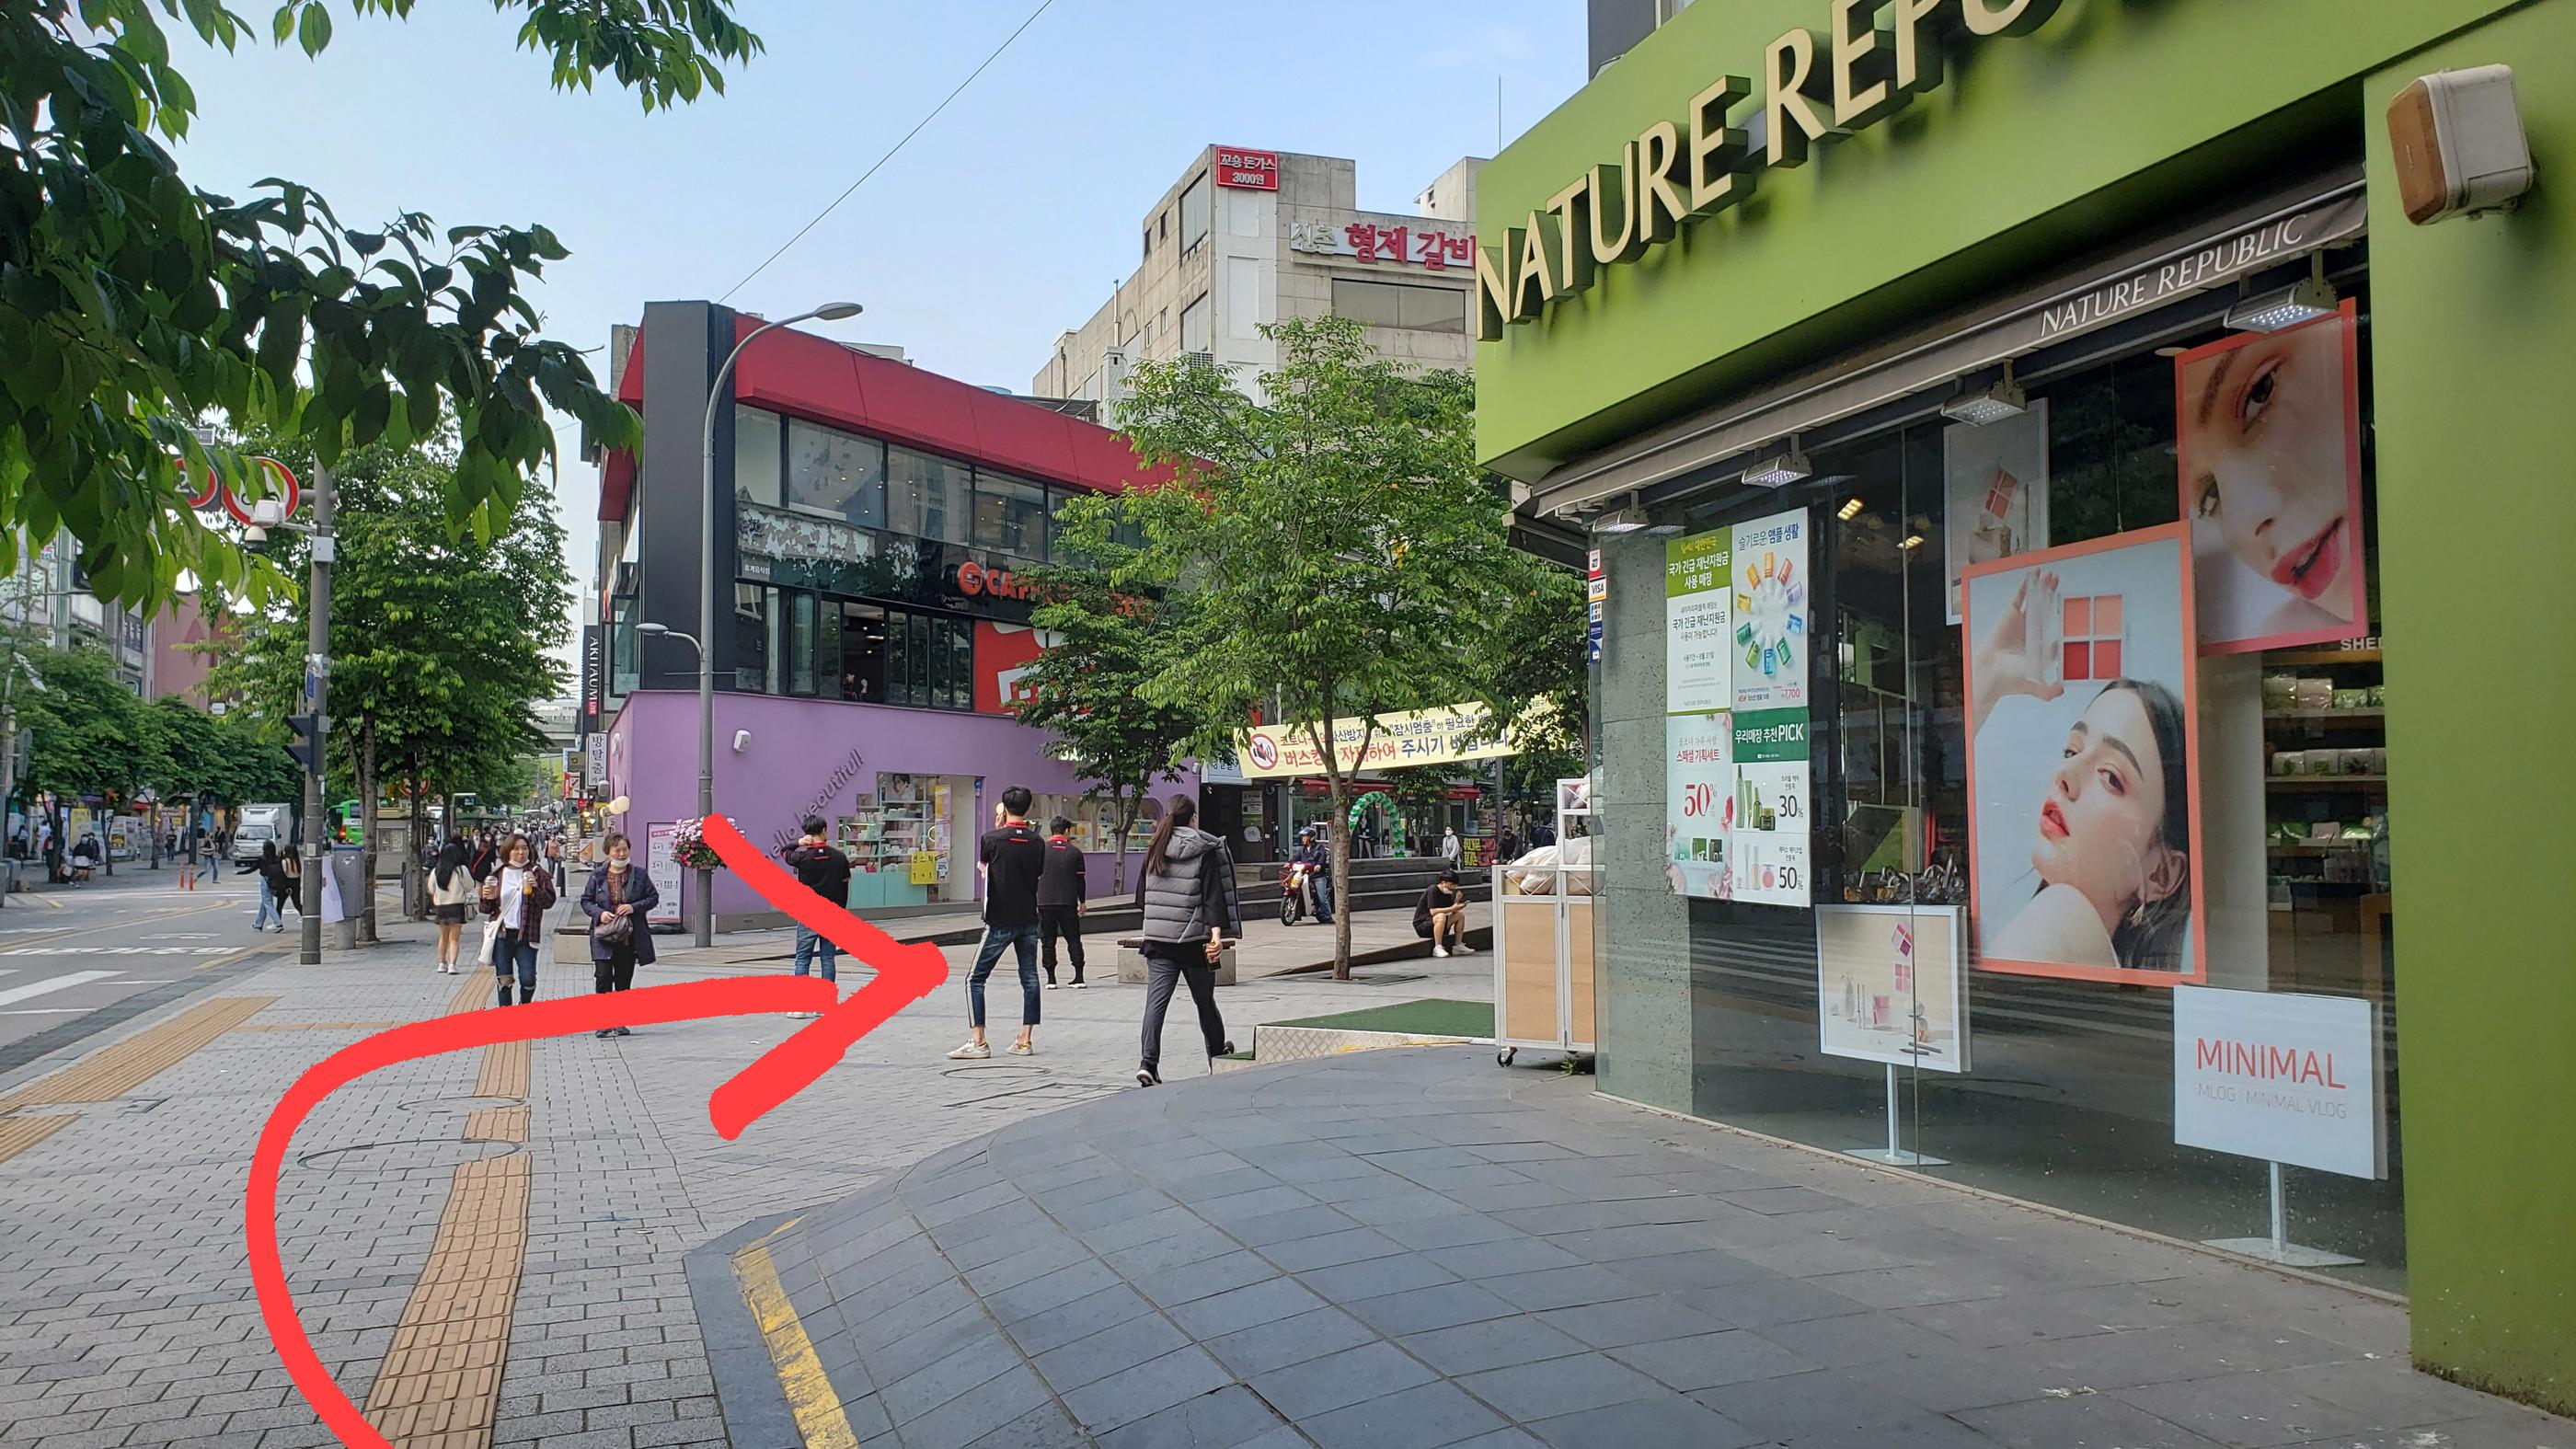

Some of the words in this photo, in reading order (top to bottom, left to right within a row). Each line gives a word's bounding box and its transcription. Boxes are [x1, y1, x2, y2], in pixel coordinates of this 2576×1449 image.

[1244, 155, 1276, 170] 돈가스
[1475, 74, 1737, 331] NATURE
[1765, 0, 2031, 167] REP
[1232, 172, 1265, 185] 3000원
[1291, 223, 1338, 255] 신촌
[1344, 223, 1409, 264] 형제
[1417, 230, 1477, 270] 갈비
[2041, 272, 2147, 337] NATURE
[2156, 213, 2308, 295] REPUBLIC
[1738, 530, 1767, 551] 슬기로운
[1768, 526, 1783, 545] 앰플
[1784, 522, 1800, 541] 생활
[1668, 561, 1682, 577] 국가
[1683, 558, 1696, 574] 긴급
[1696, 550, 1730, 570] 재난지원금
[1591, 582, 1604, 594] VISA
[1685, 574, 1698, 589] 사용
[1699, 571, 1713, 587] 매장
[1673, 617, 1684, 631] 국가
[1685, 615, 1696, 628] 긴급
[1697, 611, 1726, 627] 재난지원금
[1444, 715, 1475, 730] 필요한
[1735, 728, 1763, 744] 우리매장
[1764, 727, 1777, 743] 추천
[1778, 723, 1804, 742] PICK
[1401, 735, 1444, 759] 주시기
[1696, 748, 1720, 763] 기획세트
[2196, 1037, 2346, 1089] MINIMAL
[2198, 1083, 2237, 1102] MLOG
[2246, 1089, 2305, 1113] MINIMAL
[2307, 1099, 2347, 1120] VLOG
